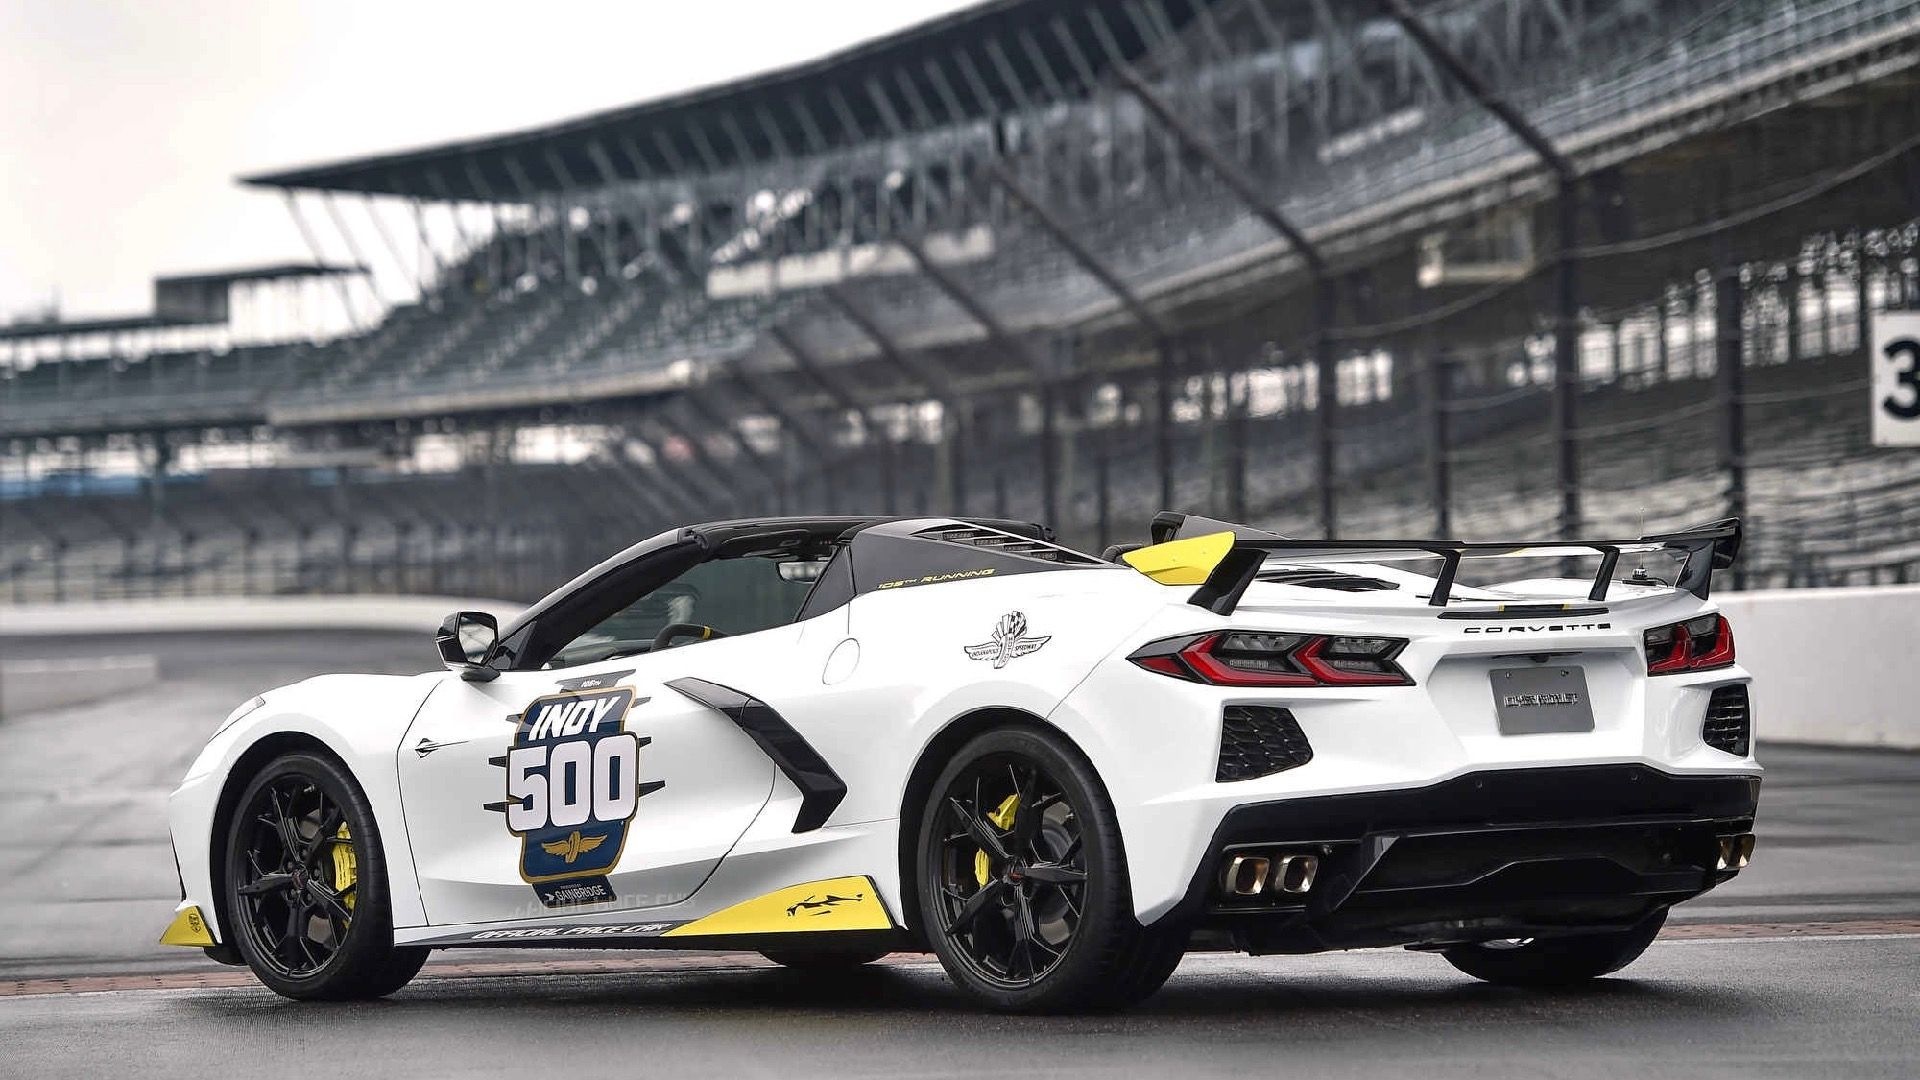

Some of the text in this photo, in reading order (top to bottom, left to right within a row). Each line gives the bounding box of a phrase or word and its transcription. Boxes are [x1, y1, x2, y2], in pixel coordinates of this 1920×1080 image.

[1884, 339, 1920, 418] 3
[921, 568, 995, 582] RUNNING
[1463, 623, 1611, 634] CORVETTE
[528, 695, 622, 741] INDY
[509, 735, 637, 831] 500
[555, 884, 606, 901] GAINBRIDGE
